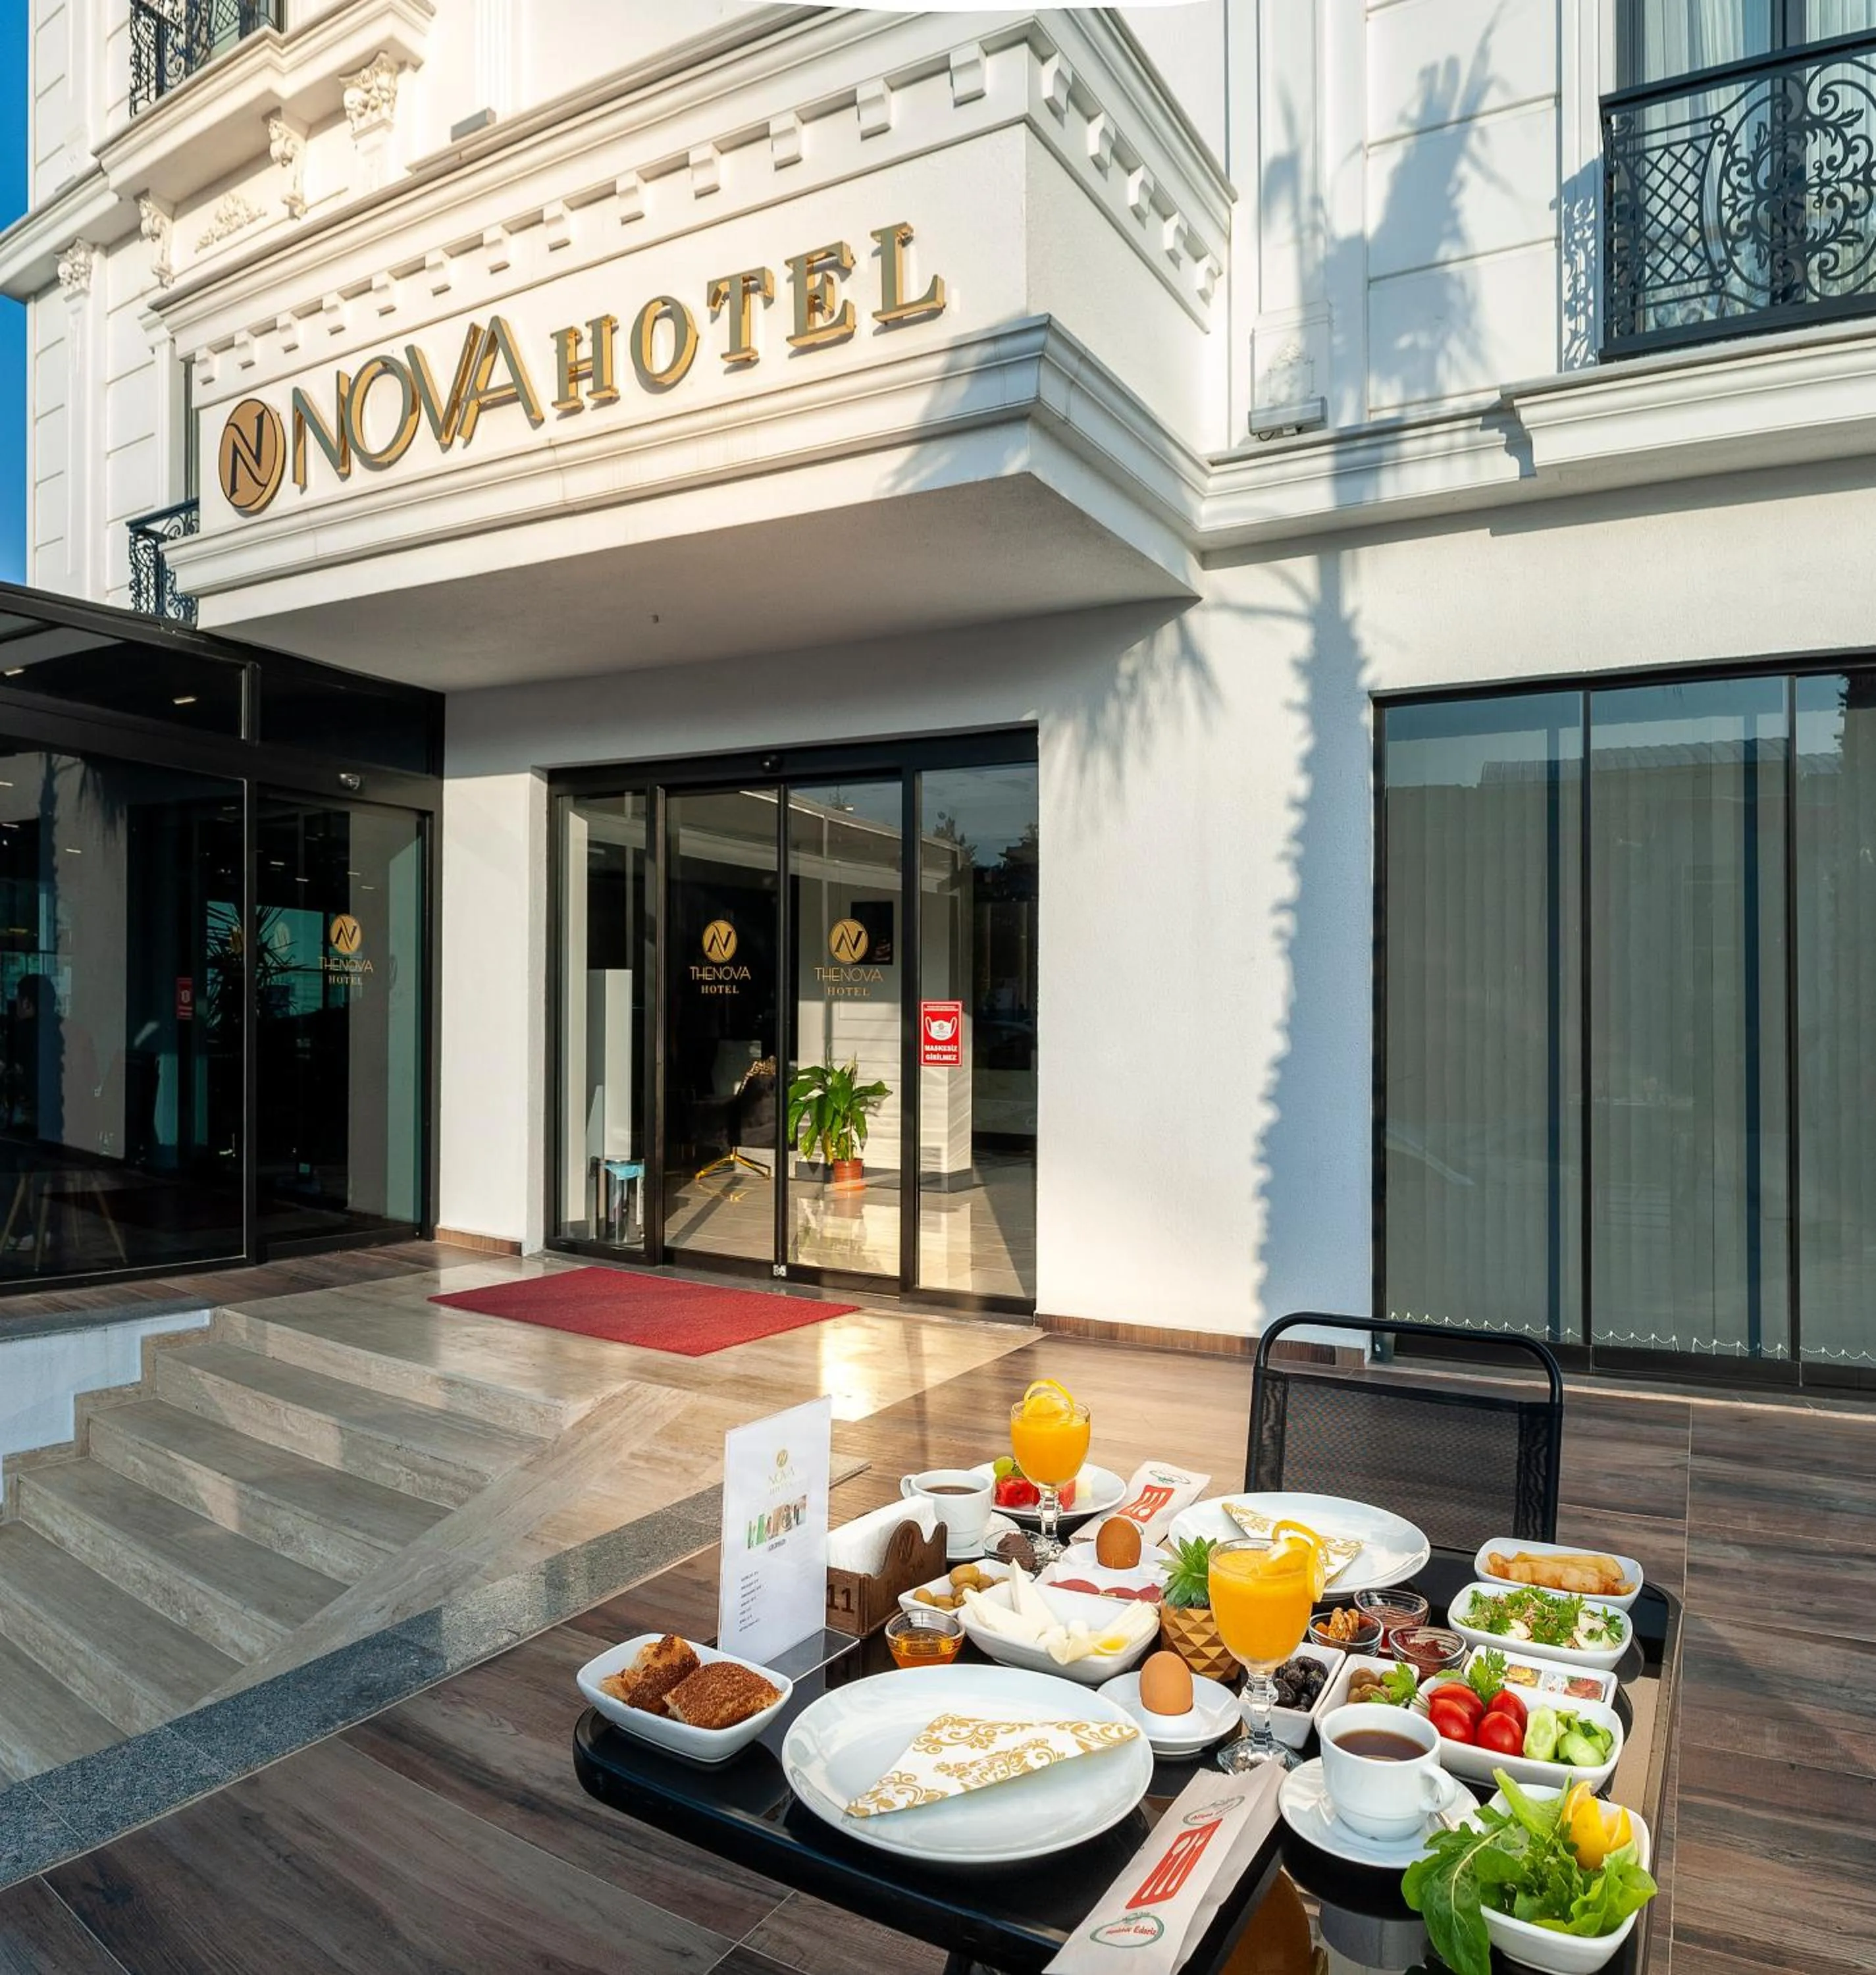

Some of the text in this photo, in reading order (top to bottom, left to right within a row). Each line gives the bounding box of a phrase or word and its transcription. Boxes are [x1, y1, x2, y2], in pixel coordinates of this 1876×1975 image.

[291, 315, 545, 488] NOVA
[550, 221, 947, 412] HOTEL
[328, 976, 363, 985] HOTEL
[701, 985, 739, 993] HOTEL
[827, 987, 870, 996] HOTEL
[827, 1583, 854, 1613] 11
